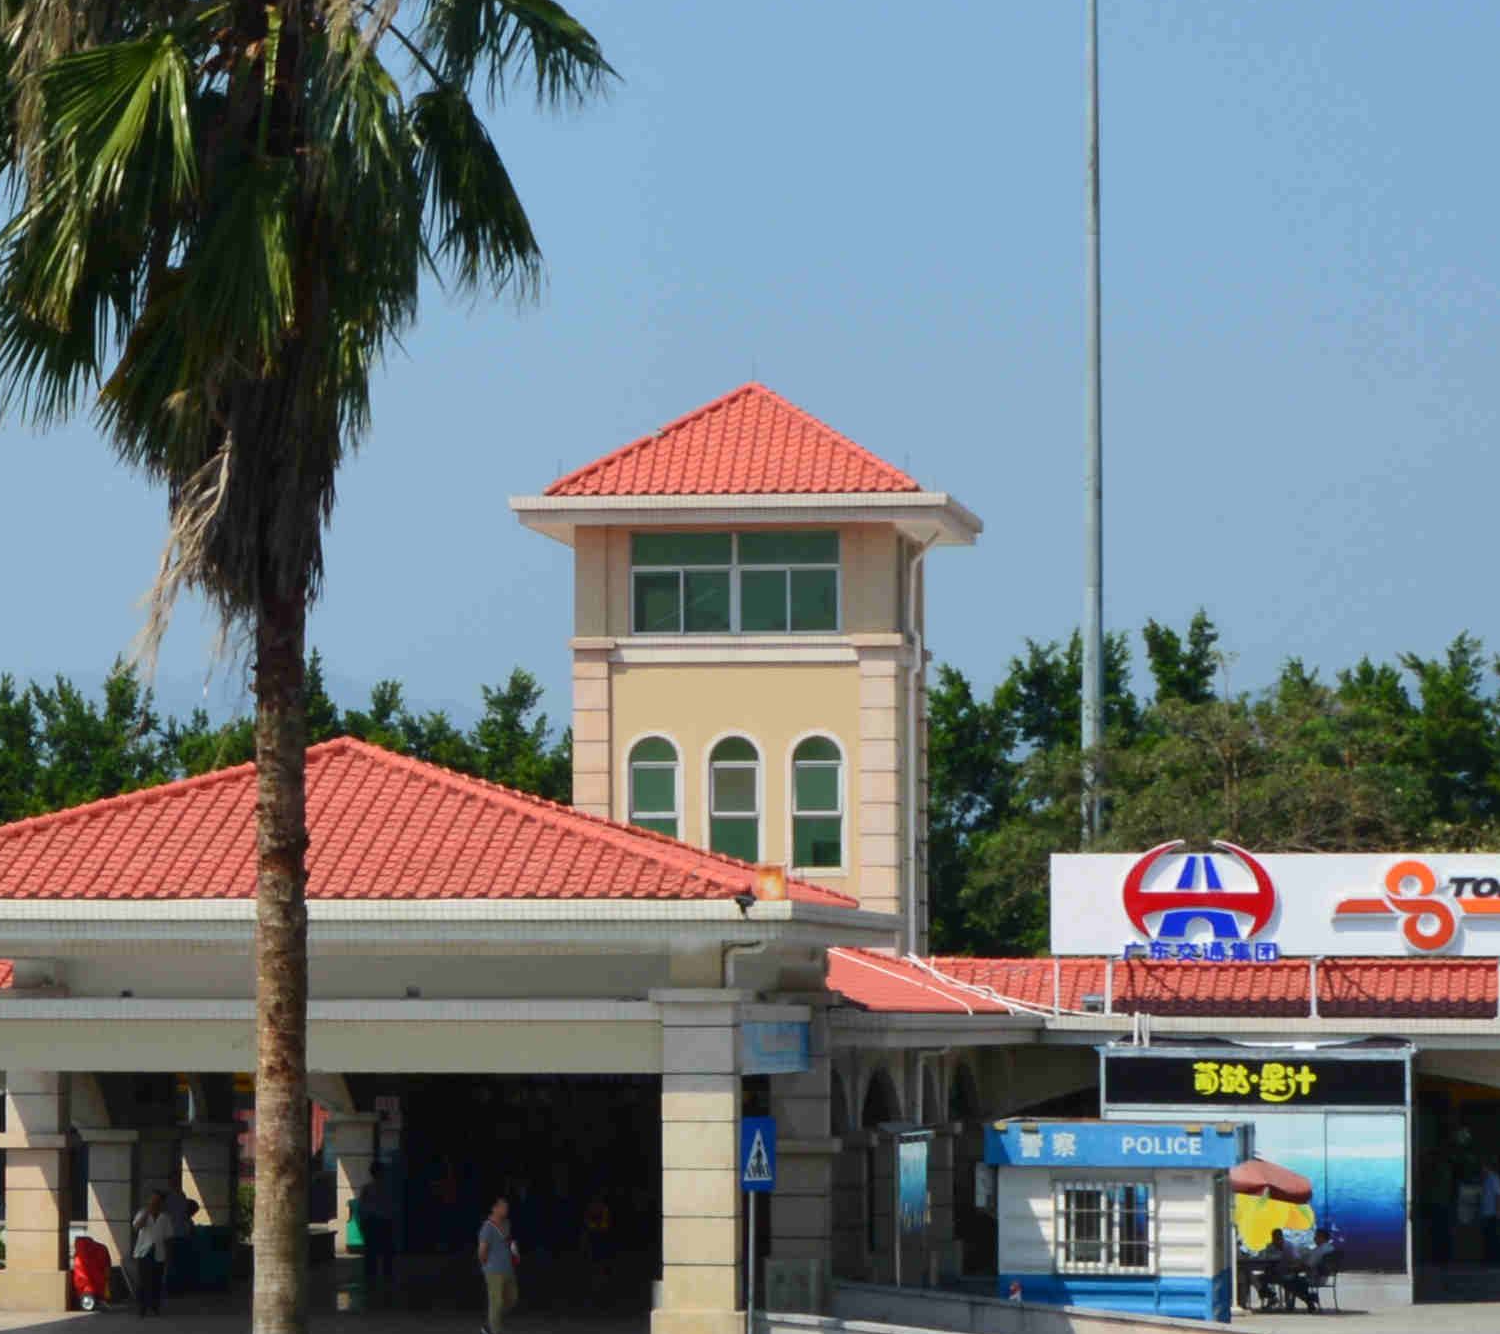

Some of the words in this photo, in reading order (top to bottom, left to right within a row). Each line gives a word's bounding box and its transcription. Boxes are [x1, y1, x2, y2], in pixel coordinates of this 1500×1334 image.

[1123, 941, 1278, 963] 广东交通集团
[1121, 1135, 1204, 1156] POLICE
